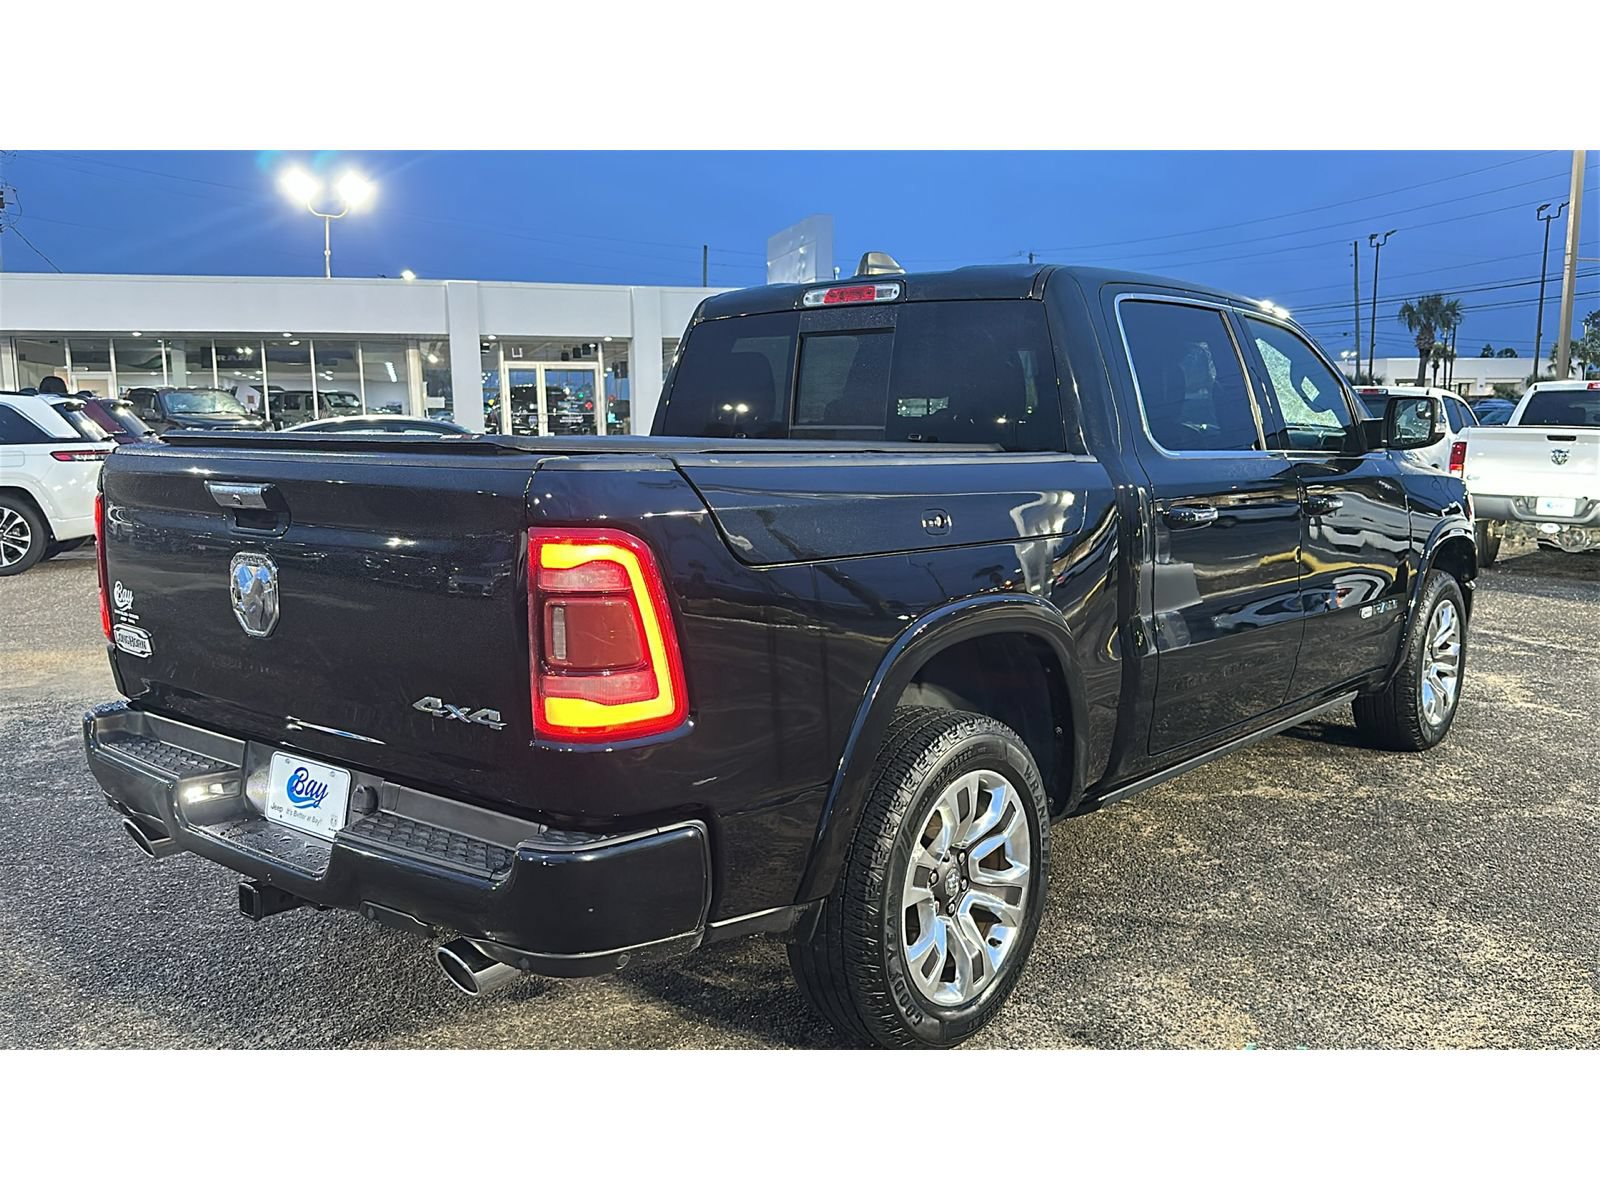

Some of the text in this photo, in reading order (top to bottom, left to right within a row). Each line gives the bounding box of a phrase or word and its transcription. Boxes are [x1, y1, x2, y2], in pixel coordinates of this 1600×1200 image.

[114, 581, 134, 610] Bay
[287, 767, 329, 809] Bay
[886, 893, 923, 1027] GOODYEAR
